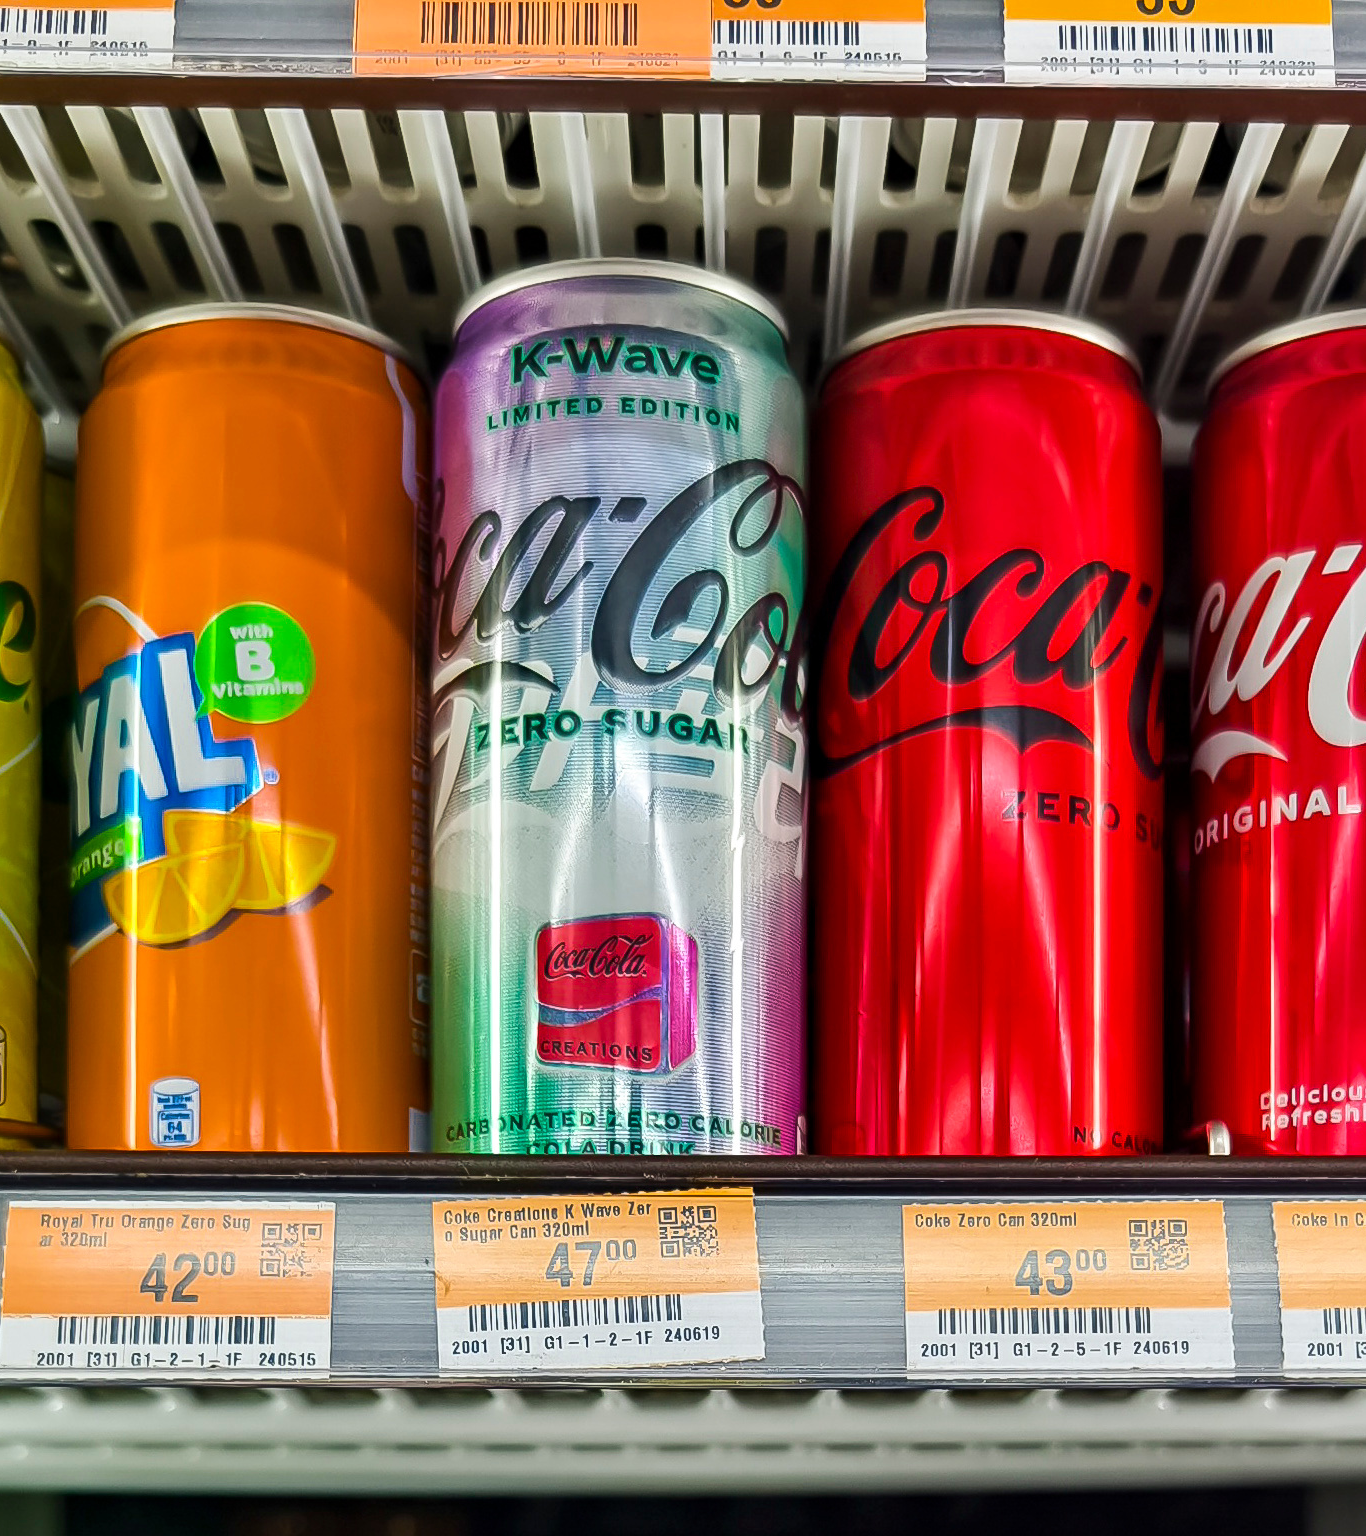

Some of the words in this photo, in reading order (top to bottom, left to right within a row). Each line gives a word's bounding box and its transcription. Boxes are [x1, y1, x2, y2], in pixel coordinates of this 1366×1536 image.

[510, 337, 721, 385] K-Wave
[487, 397, 604, 432] LIMITED
[619, 397, 741, 433] EDITION
[229, 625, 274, 641] With
[235, 641, 275, 681] B
[211, 679, 304, 698] Vitamins
[475, 707, 584, 754] ZERO
[600, 707, 751, 755] SUGAR
[1001, 790, 1120, 831] ZERO
[1193, 790, 1361, 855] ORIGINAL
[544, 933, 653, 981] Coca-Cola
[540, 1039, 653, 1063] CREATIONS
[606, 1110, 681, 1131] ZERO
[690, 1114, 781, 1147] CALORIE
[40, 1214, 82, 1231] Royal
[92, 1214, 114, 1228] Tru
[122, 1214, 174, 1232] Orange
[182, 1215, 215, 1229] Zero
[223, 1215, 250, 1232] Sug
[444, 1209, 480, 1225] Coke
[487, 1207, 558, 1223] Creations
[581, 1203, 620, 1218] Wave
[628, 1202, 653, 1216] Zer
[915, 1213, 951, 1228] Coke
[958, 1214, 991, 1227] Zero
[998, 1213, 1025, 1227] Can
[1031, 1212, 1077, 1227] 320ml
[1292, 1212, 1327, 1226] Coke
[60, 1232, 108, 1247] 320ml
[459, 1225, 502, 1243] Sugar
[509, 1225, 536, 1239] Can
[542, 1222, 589, 1237] 320ml
[37, 1353, 73, 1366] 2001
[87, 1352, 117, 1367] [31]
[259, 1353, 315, 1366] 240515
